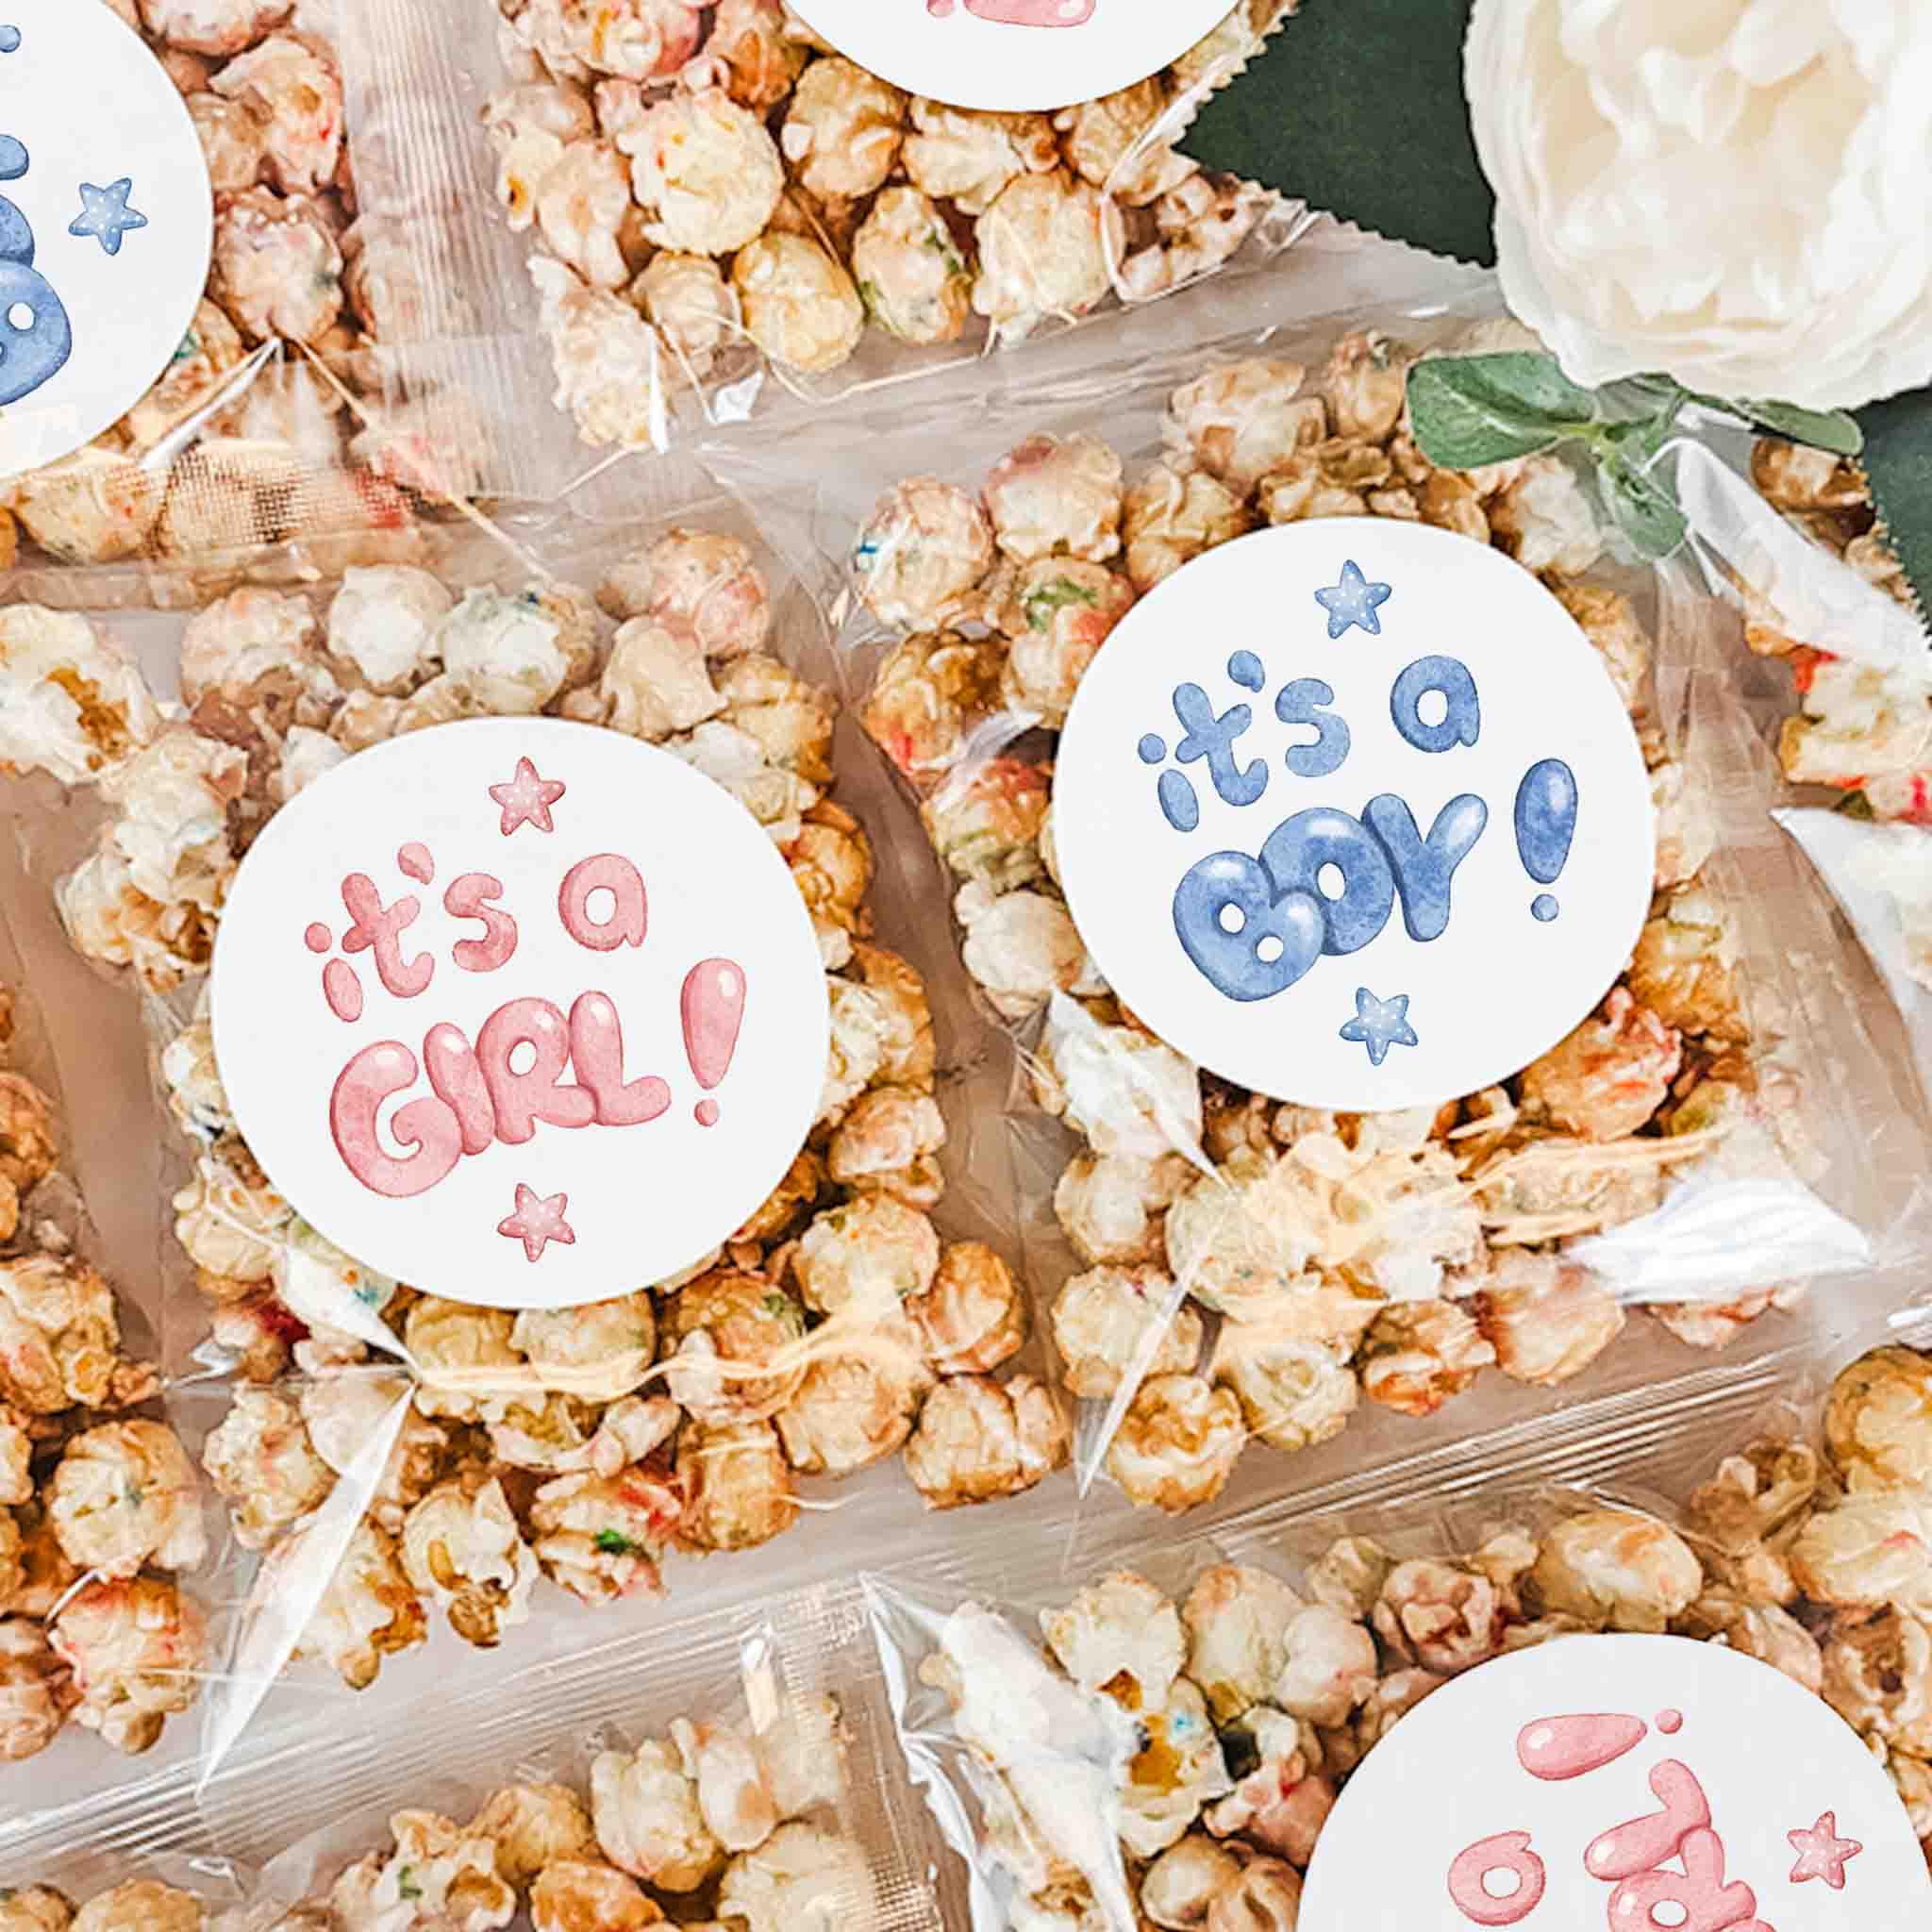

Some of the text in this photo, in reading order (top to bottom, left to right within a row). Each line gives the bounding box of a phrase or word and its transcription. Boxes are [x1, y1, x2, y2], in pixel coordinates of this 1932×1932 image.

[1138, 650, 1480, 832] it's a
[303, 841, 648, 1024] it's a
[1173, 757, 1579, 1002] BOY!
[328, 958, 747, 1198] GIRL!
